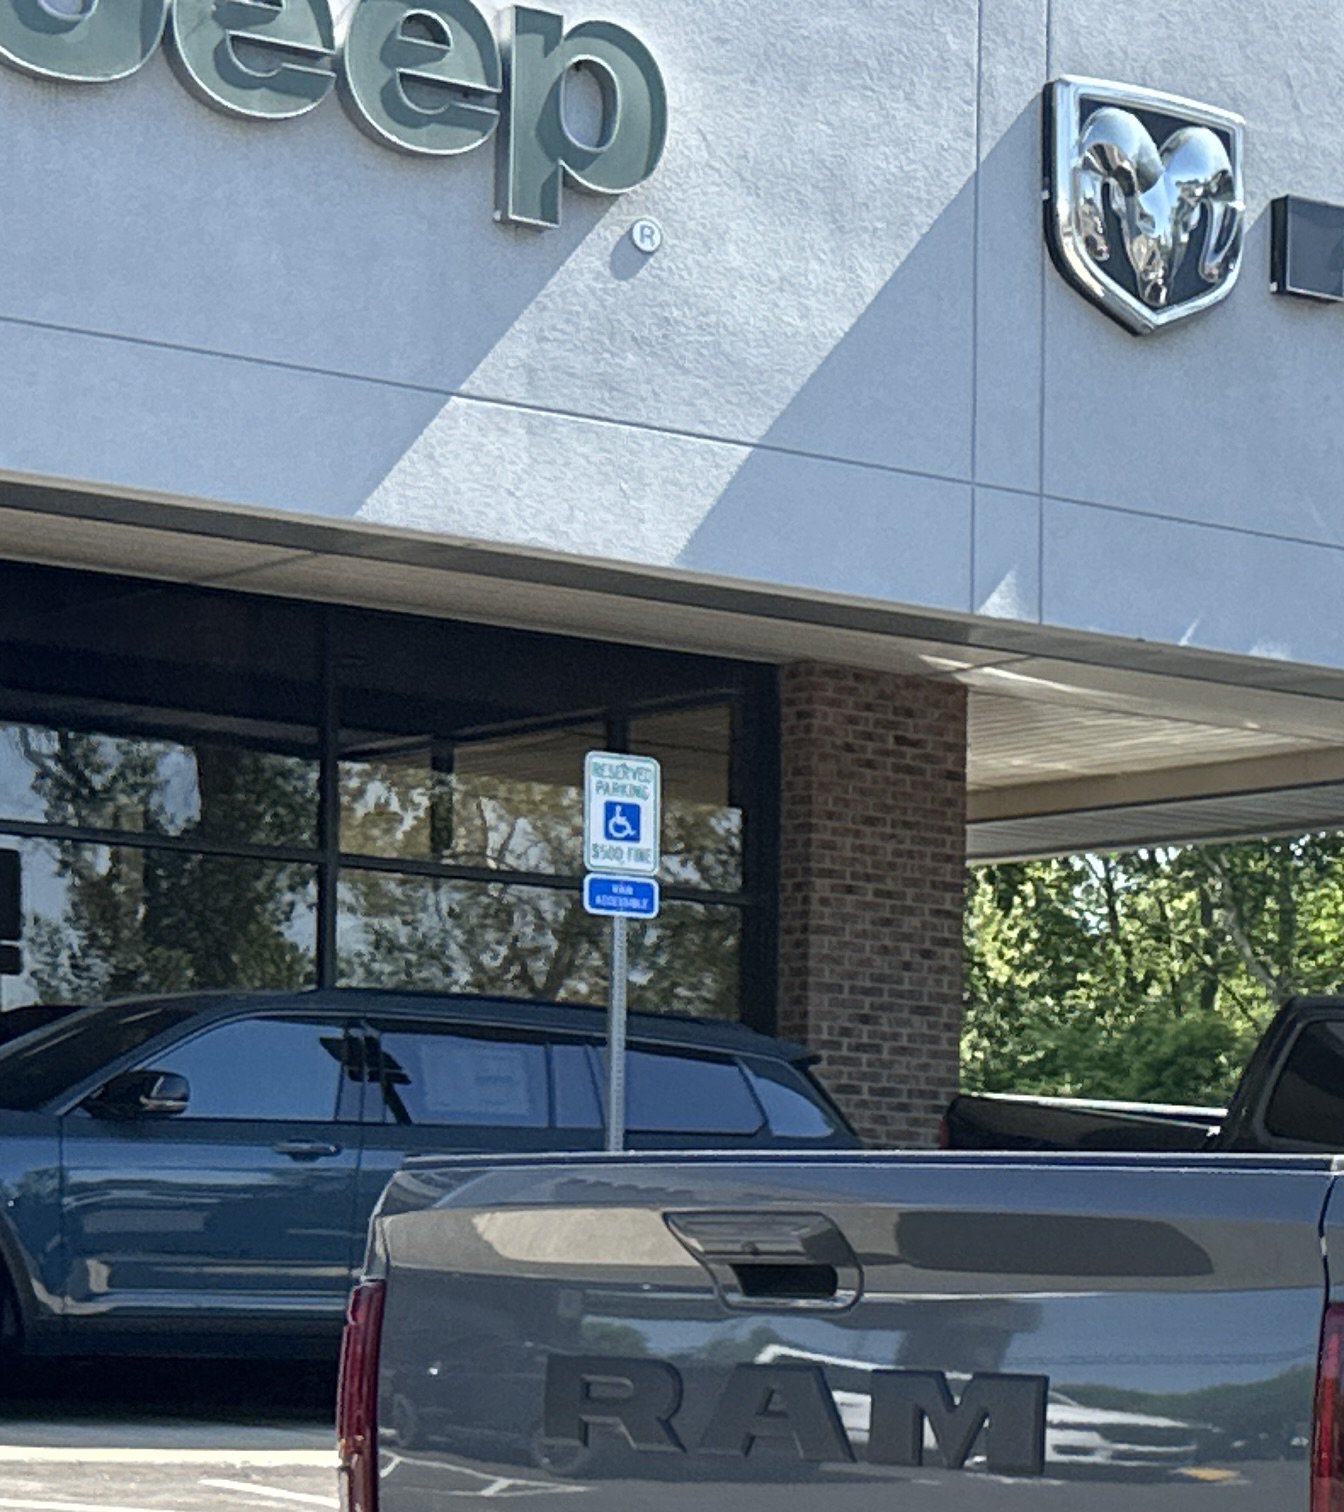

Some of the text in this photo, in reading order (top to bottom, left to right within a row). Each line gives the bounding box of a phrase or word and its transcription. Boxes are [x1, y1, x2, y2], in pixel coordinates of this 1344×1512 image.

[592, 762, 653, 783] RESERVED
[595, 780, 650, 801] PARKING
[544, 1353, 1050, 1477] RAM
